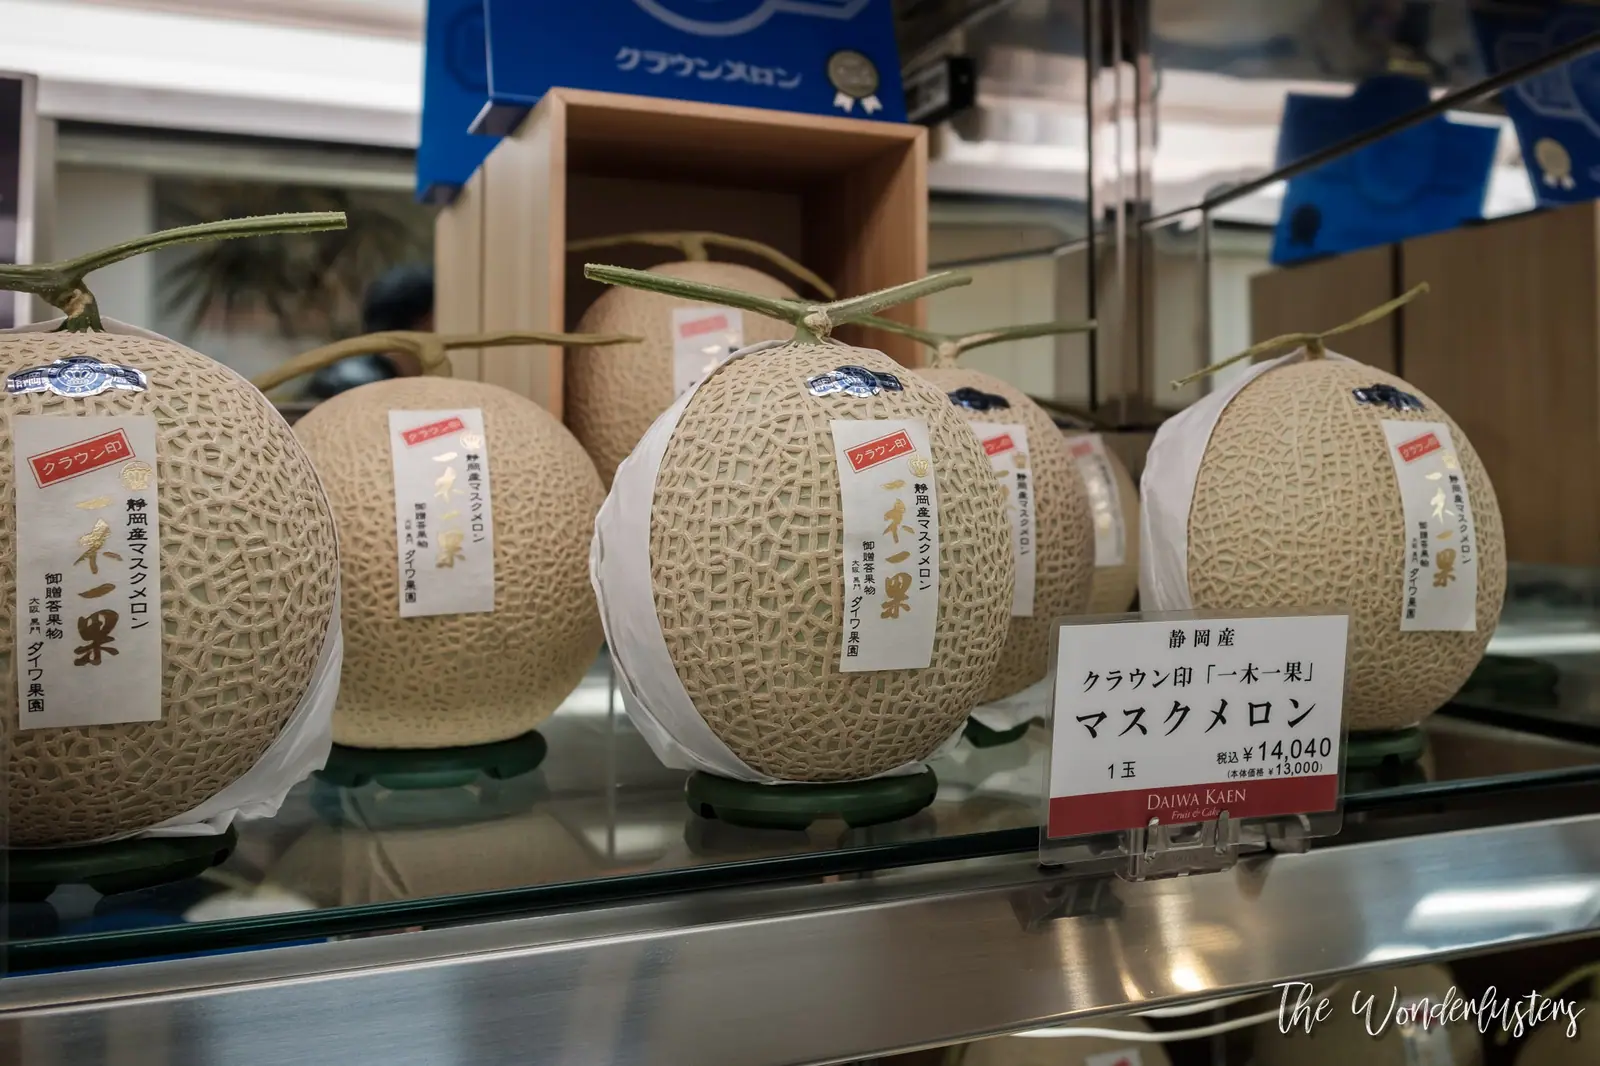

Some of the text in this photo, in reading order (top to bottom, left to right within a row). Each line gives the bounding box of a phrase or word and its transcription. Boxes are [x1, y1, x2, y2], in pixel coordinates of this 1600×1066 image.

[615, 46, 802, 89] クラウンメロン
[42, 440, 123, 476] クラウン印
[855, 437, 907, 464] クラウン印
[880, 479, 915, 619] 一木一果
[914, 483, 932, 591] 静岡産マスクメロン
[73, 496, 124, 666] 一木一果
[126, 498, 149, 629] 静岡産マスクメロン
[862, 540, 876, 596] 御贈答果物
[45, 572, 64, 640] 御贈答果物
[847, 596, 863, 657] ダイワ果園
[1168, 627, 1236, 649] 静岡産
[27, 641, 45, 713] ダイワ果園
[1083, 661, 1314, 693] クラウン印「一木一果」
[1075, 698, 1317, 739] マスクメロン
[1147, 788, 1247, 811] DAIWA KAEN
[1171, 810, 1191, 820] Fruit
